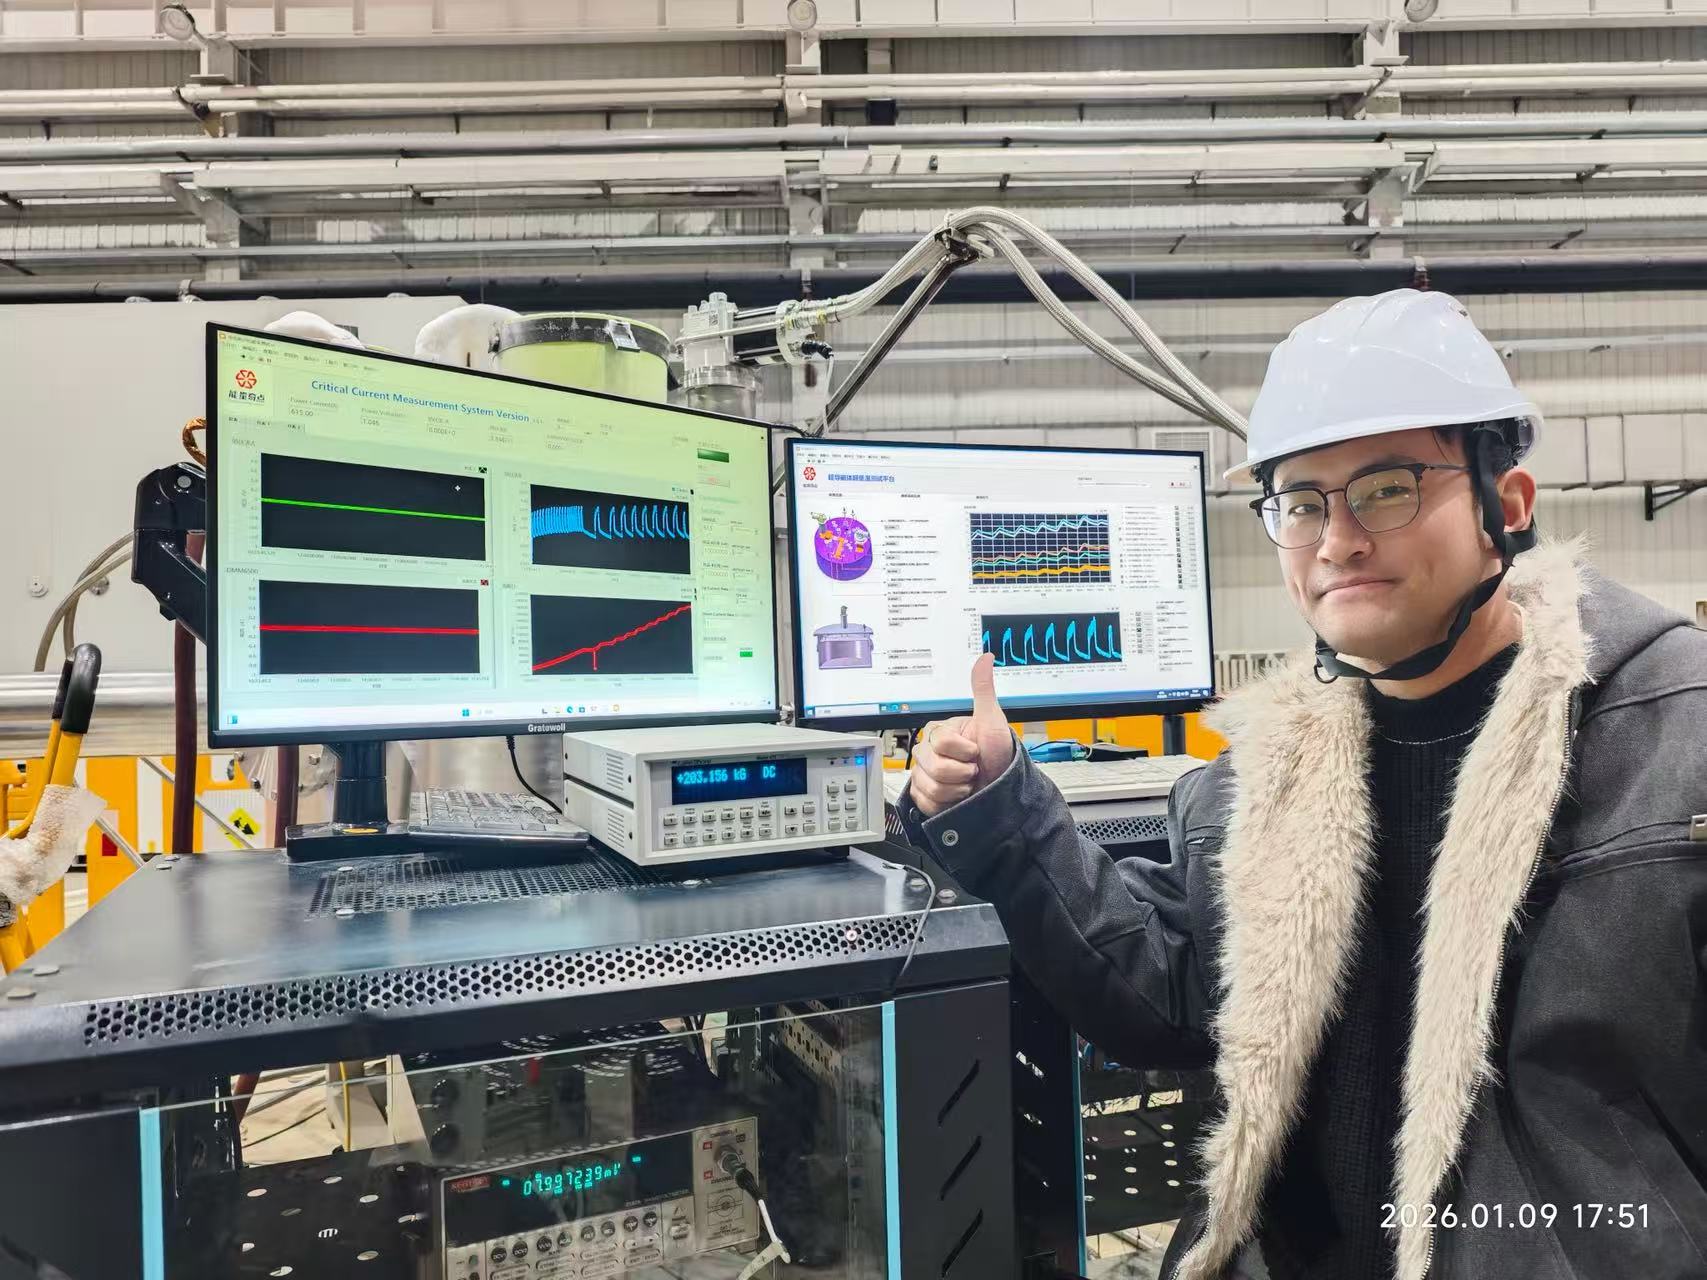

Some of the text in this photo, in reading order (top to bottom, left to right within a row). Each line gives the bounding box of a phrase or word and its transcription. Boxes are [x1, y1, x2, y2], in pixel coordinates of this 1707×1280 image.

[311, 380, 348, 394] Critical
[352, 387, 389, 400] Current
[393, 393, 458, 411] Measurement
[461, 404, 494, 417] System
[496, 410, 529, 422] Version
[733, 768, 747, 780] kG
[762, 765, 776, 778] DC
